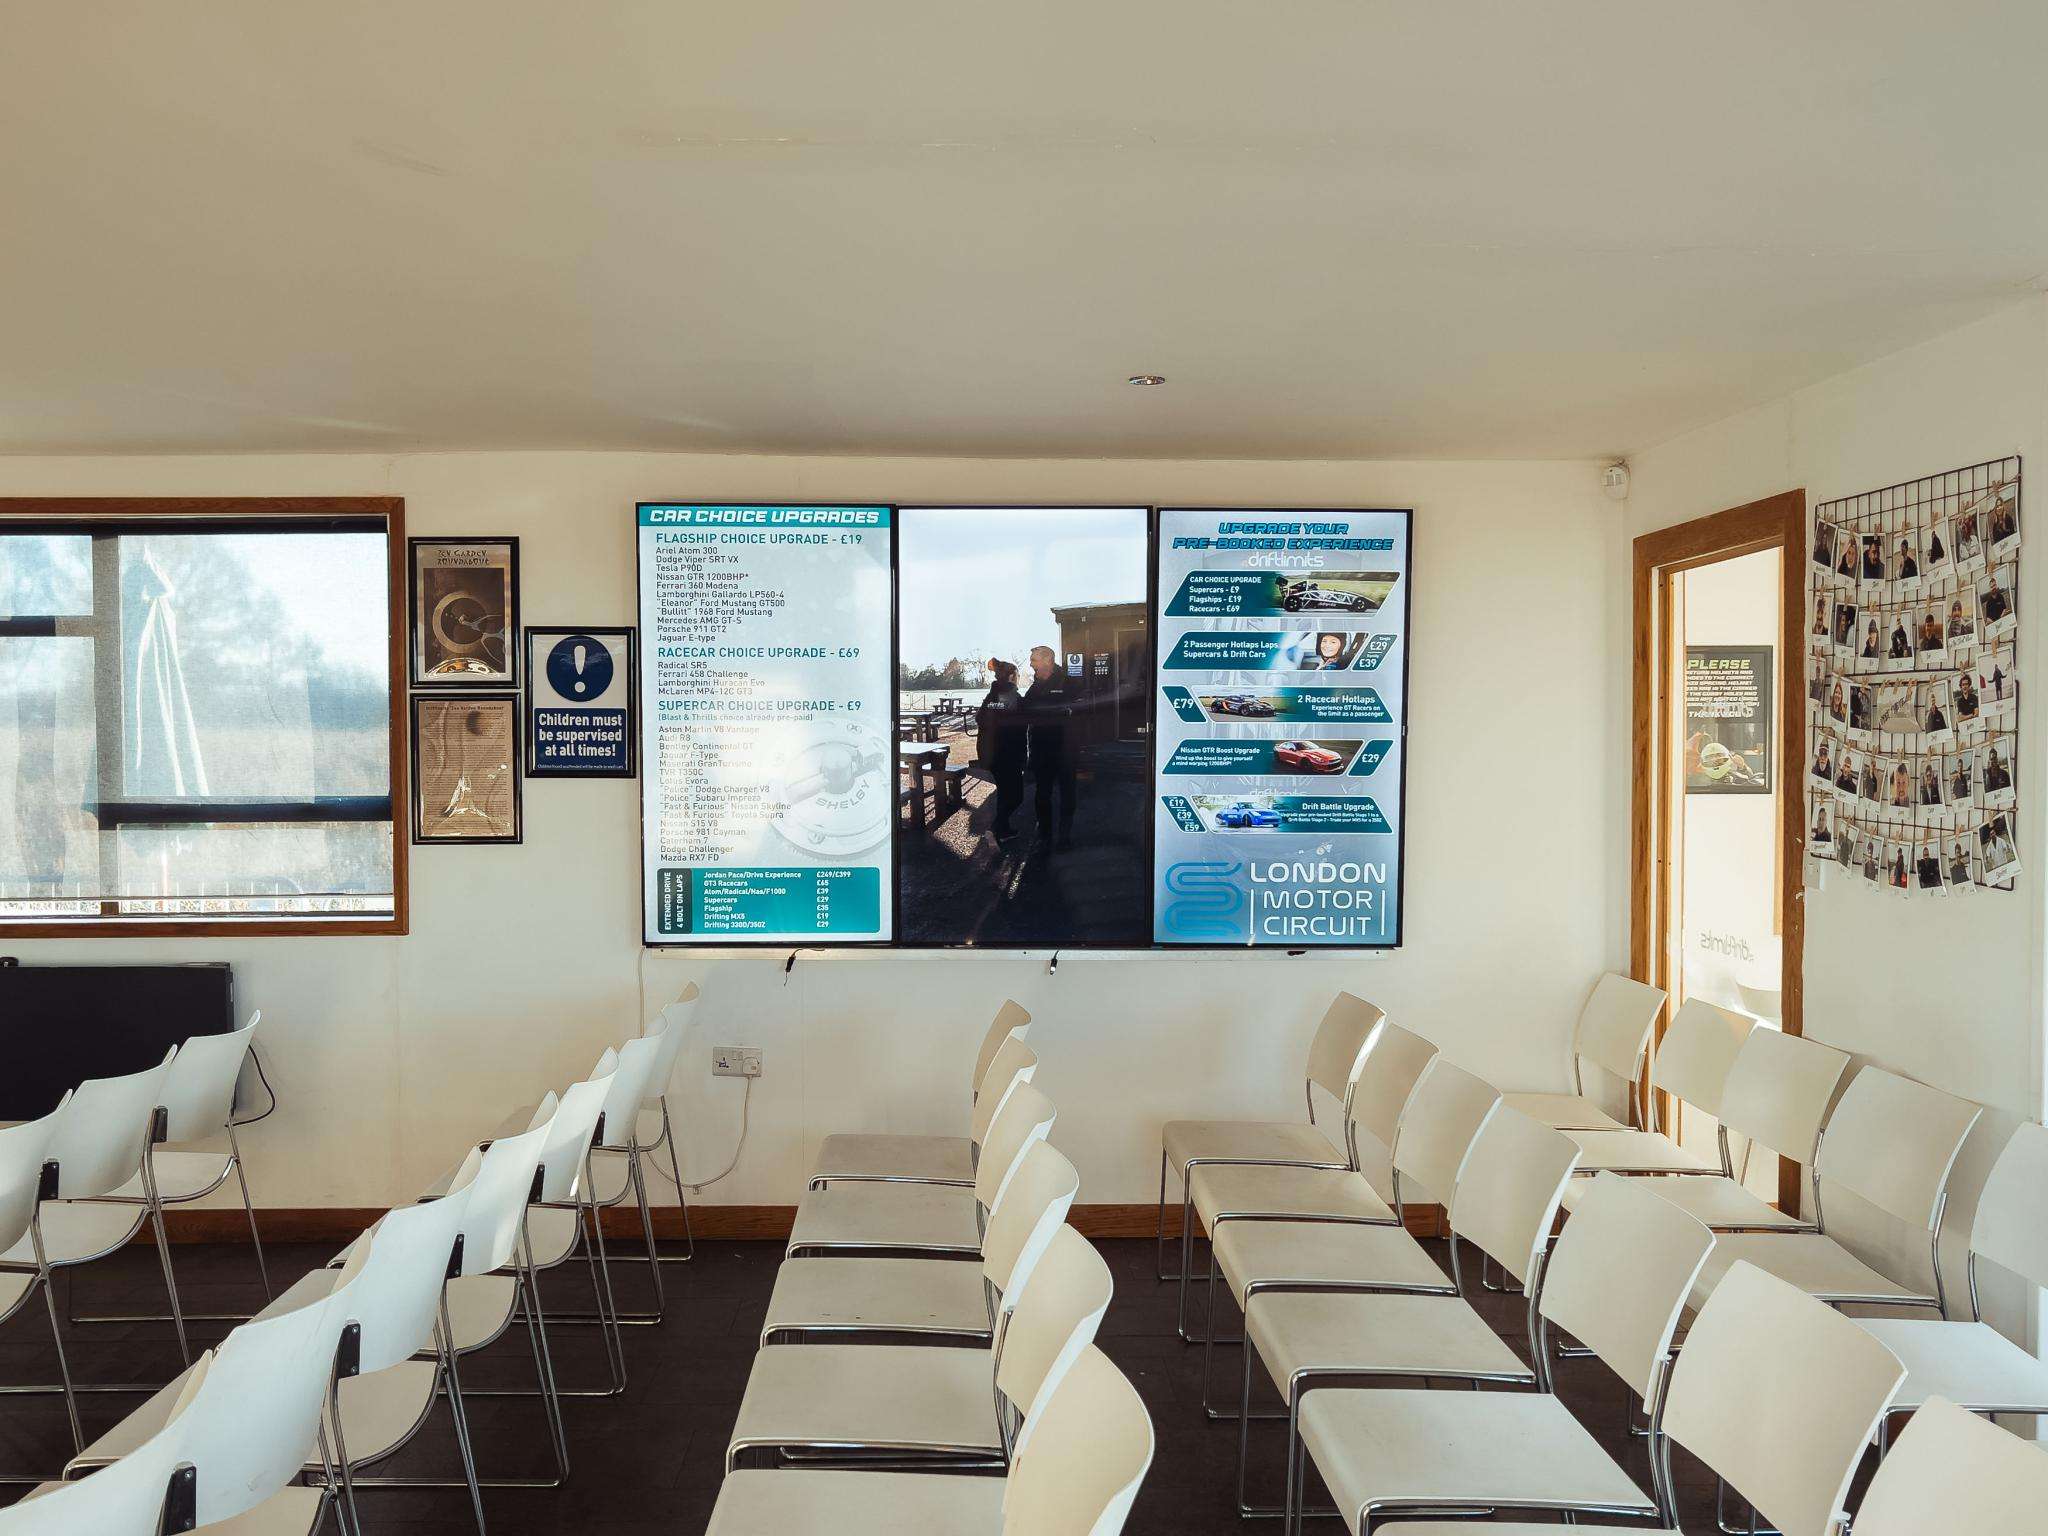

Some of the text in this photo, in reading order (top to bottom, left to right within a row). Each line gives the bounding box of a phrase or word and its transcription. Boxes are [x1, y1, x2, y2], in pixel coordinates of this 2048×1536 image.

[650, 510, 879, 522] CAR CHOICE UPGRADES
[1219, 523, 1349, 534] UPGRADE YOUR
[657, 534, 716, 544] FLAGSHIP
[721, 534, 766, 544] CHOICE
[770, 534, 828, 544] UPGRADE
[841, 534, 862, 544] £19
[1173, 538, 1394, 550] PRE-BOOKED EXPERIENCE
[656, 556, 682, 565] Dodge
[685, 556, 706, 565] Viper
[1247, 552, 1324, 566] driftlimits
[1190, 586, 1224, 594] Supercars
[657, 591, 709, 600] Lamborghini
[722, 599, 756, 608] Mustang
[738, 608, 772, 617] Mustang
[658, 635, 715, 643] Jaguar E-type
[1370, 640, 1387, 650] £29
[659, 648, 715, 657] RACECAR
[720, 648, 764, 657] CHOICE
[768, 648, 826, 657] UPGRADE
[839, 648, 859, 657] £69
[1688, 659, 1750, 669] PLEASE
[707, 670, 748, 679] Challenge
[659, 679, 710, 688] Lamborghini
[1173, 699, 1194, 709] £79
[1342, 695, 1375, 705] Hotlaps
[659, 701, 724, 710] SUPERCAR
[728, 701, 772, 710] CHOICE
[778, 701, 834, 710] UPGRADE
[848, 701, 860, 710] £9
[539, 714, 622, 726] Children must
[540, 729, 622, 743] be supervised
[546, 744, 615, 756] at all times!
[696, 786, 721, 794] Dodge
[724, 786, 757, 794] Charger
[816, 780, 870, 809] SHELBY
[1170, 799, 1184, 807] £19
[1177, 810, 1191, 819] £39
[661, 846, 732, 854] Dodge Challenger
[1251, 863, 1385, 882] LONDON
[676, 893, 683, 904] ON
[1264, 890, 1372, 908] MOTOR
[1264, 917, 1370, 935] CIRCUIT
